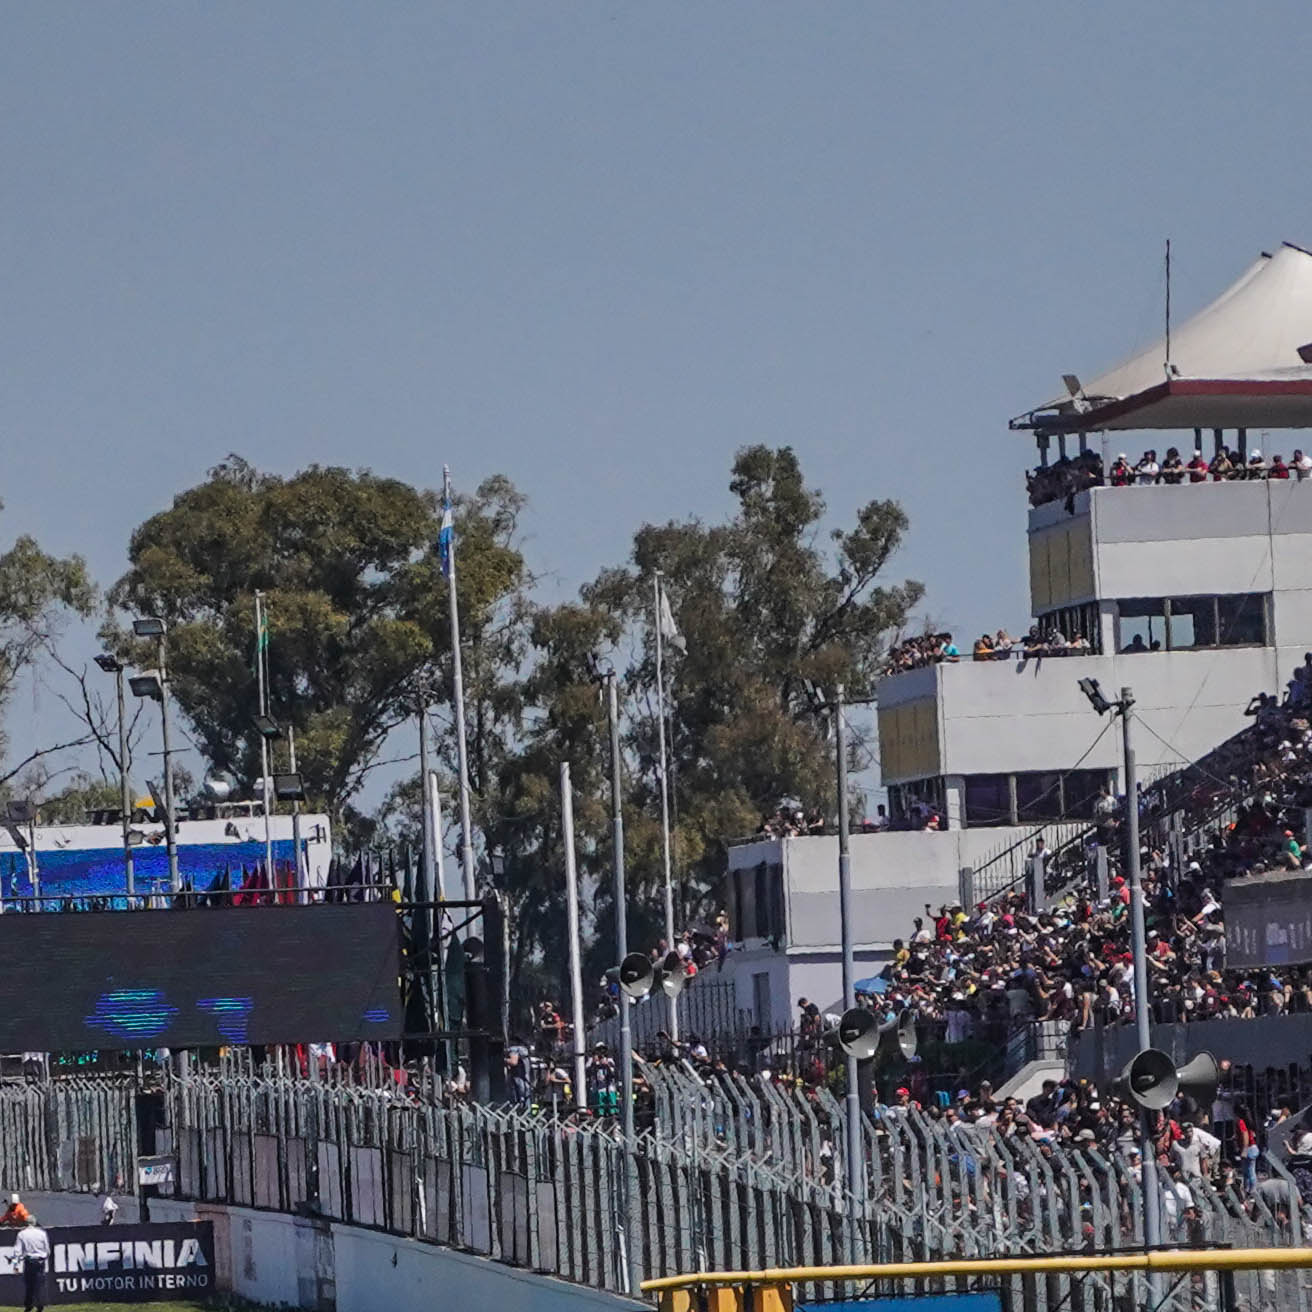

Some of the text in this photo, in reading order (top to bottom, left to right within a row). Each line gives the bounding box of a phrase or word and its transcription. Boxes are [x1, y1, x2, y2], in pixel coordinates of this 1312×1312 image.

[54, 1239, 208, 1273] INFINIA
[57, 1273, 208, 1292] TU MOTOR INTERNO
